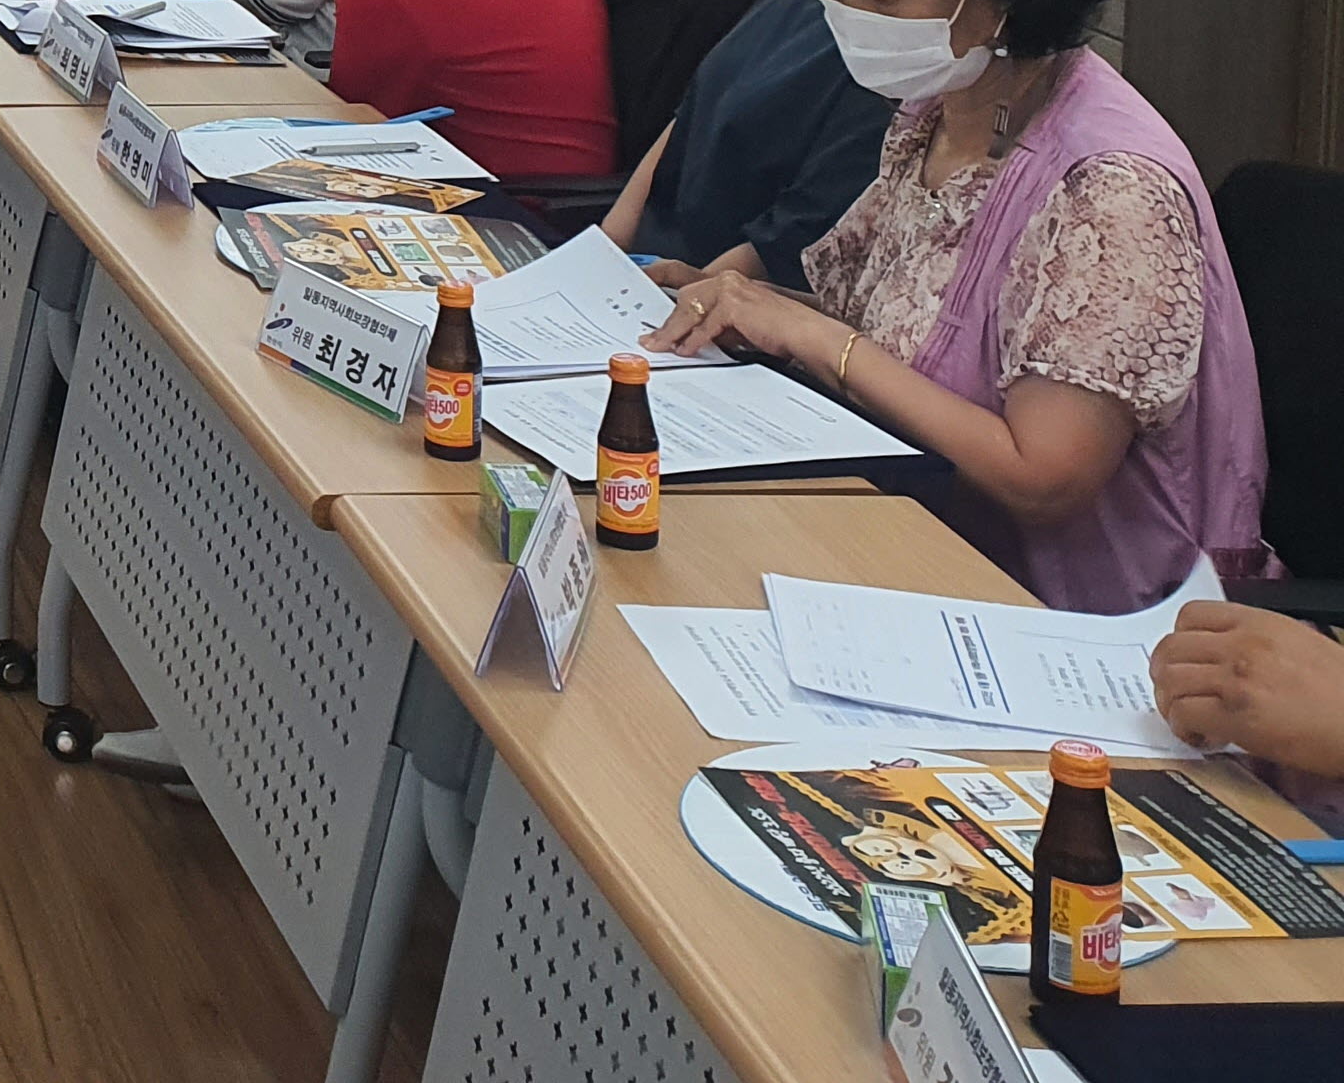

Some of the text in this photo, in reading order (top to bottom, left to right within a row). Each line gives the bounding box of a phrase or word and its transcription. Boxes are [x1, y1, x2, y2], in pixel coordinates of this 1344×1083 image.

[302, 286, 399, 344] 일동지역사회보장협의체
[292, 326, 399, 401] 위원 최경자
[603, 482, 653, 507] 비타500
